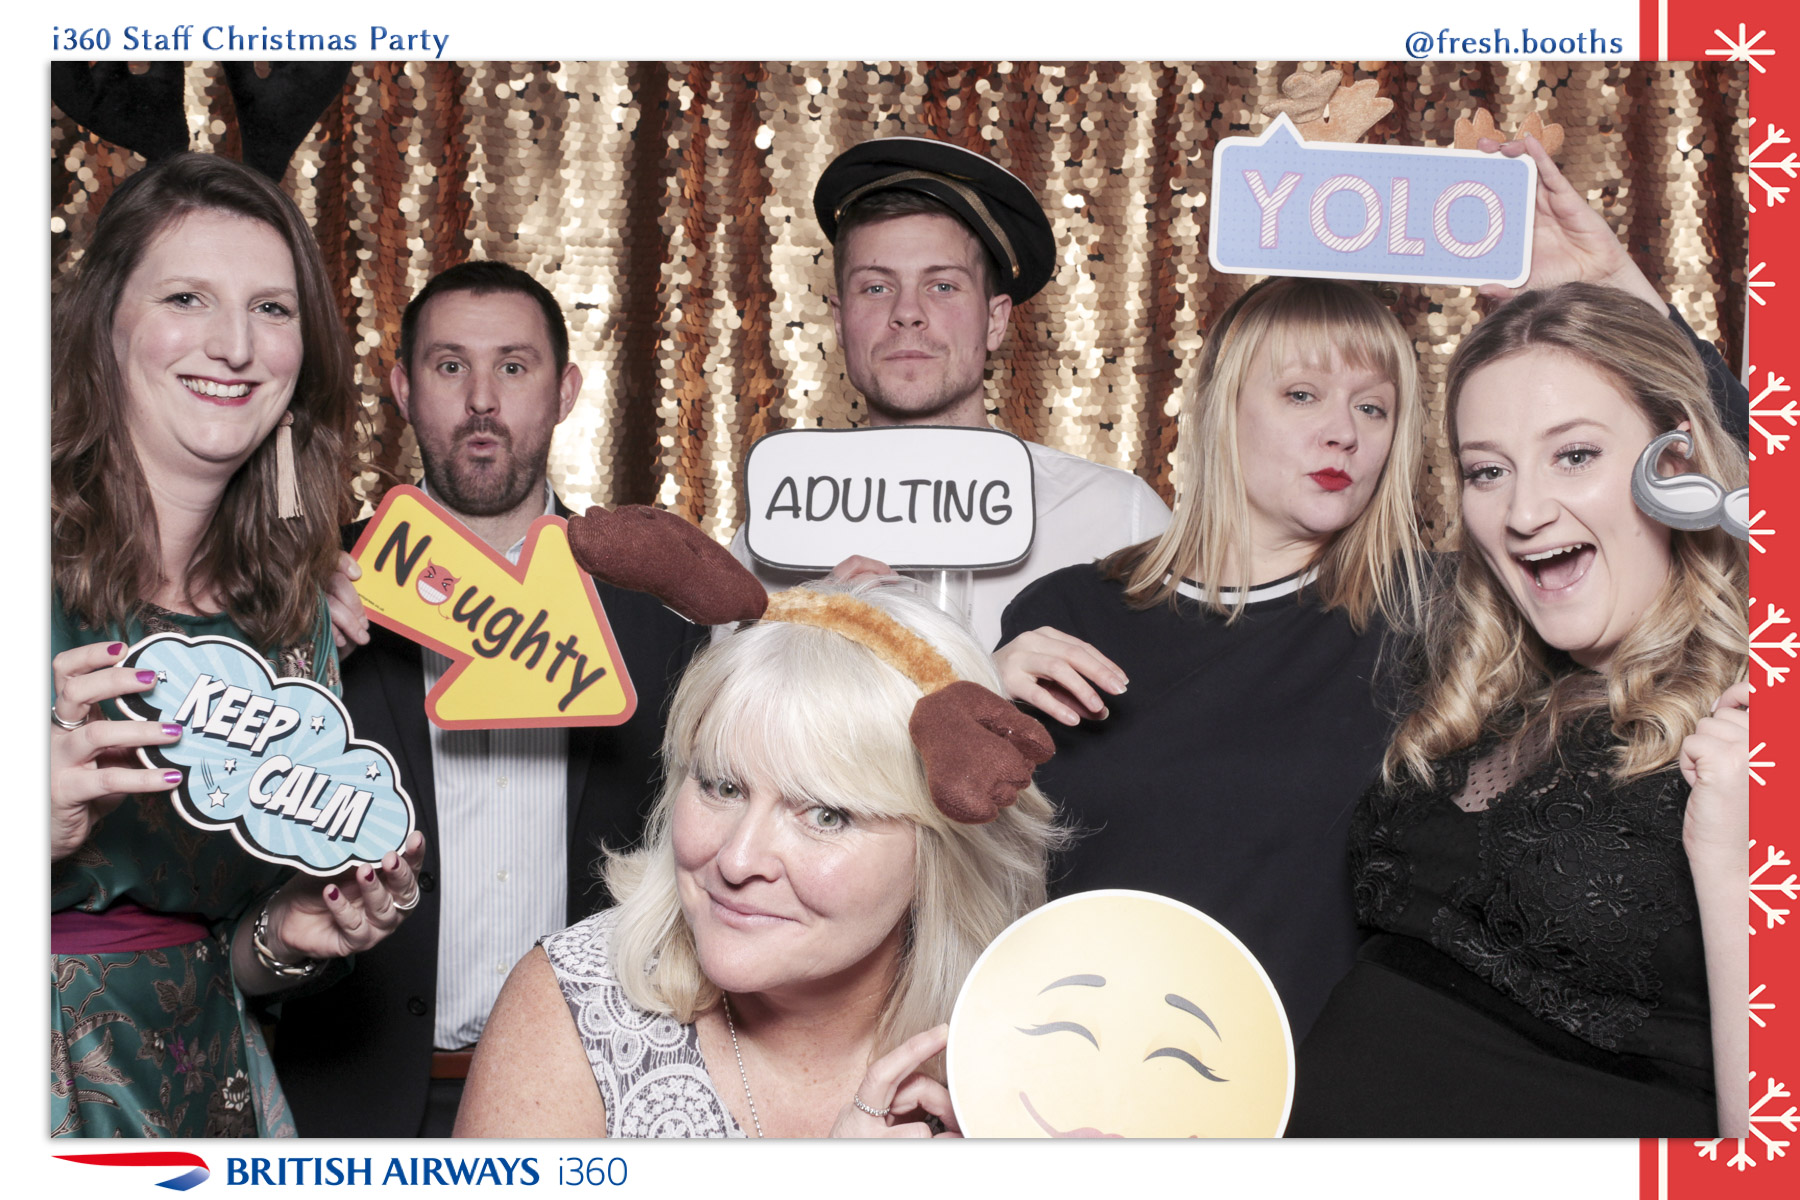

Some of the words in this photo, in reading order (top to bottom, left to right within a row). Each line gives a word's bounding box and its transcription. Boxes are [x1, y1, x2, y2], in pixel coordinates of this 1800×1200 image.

[1242, 169, 1505, 259] YOLO
[765, 476, 1013, 526] ADULTING
[374, 520, 607, 713] Nughty
[173, 673, 301, 757] KEEP
[248, 754, 374, 843] CALM
